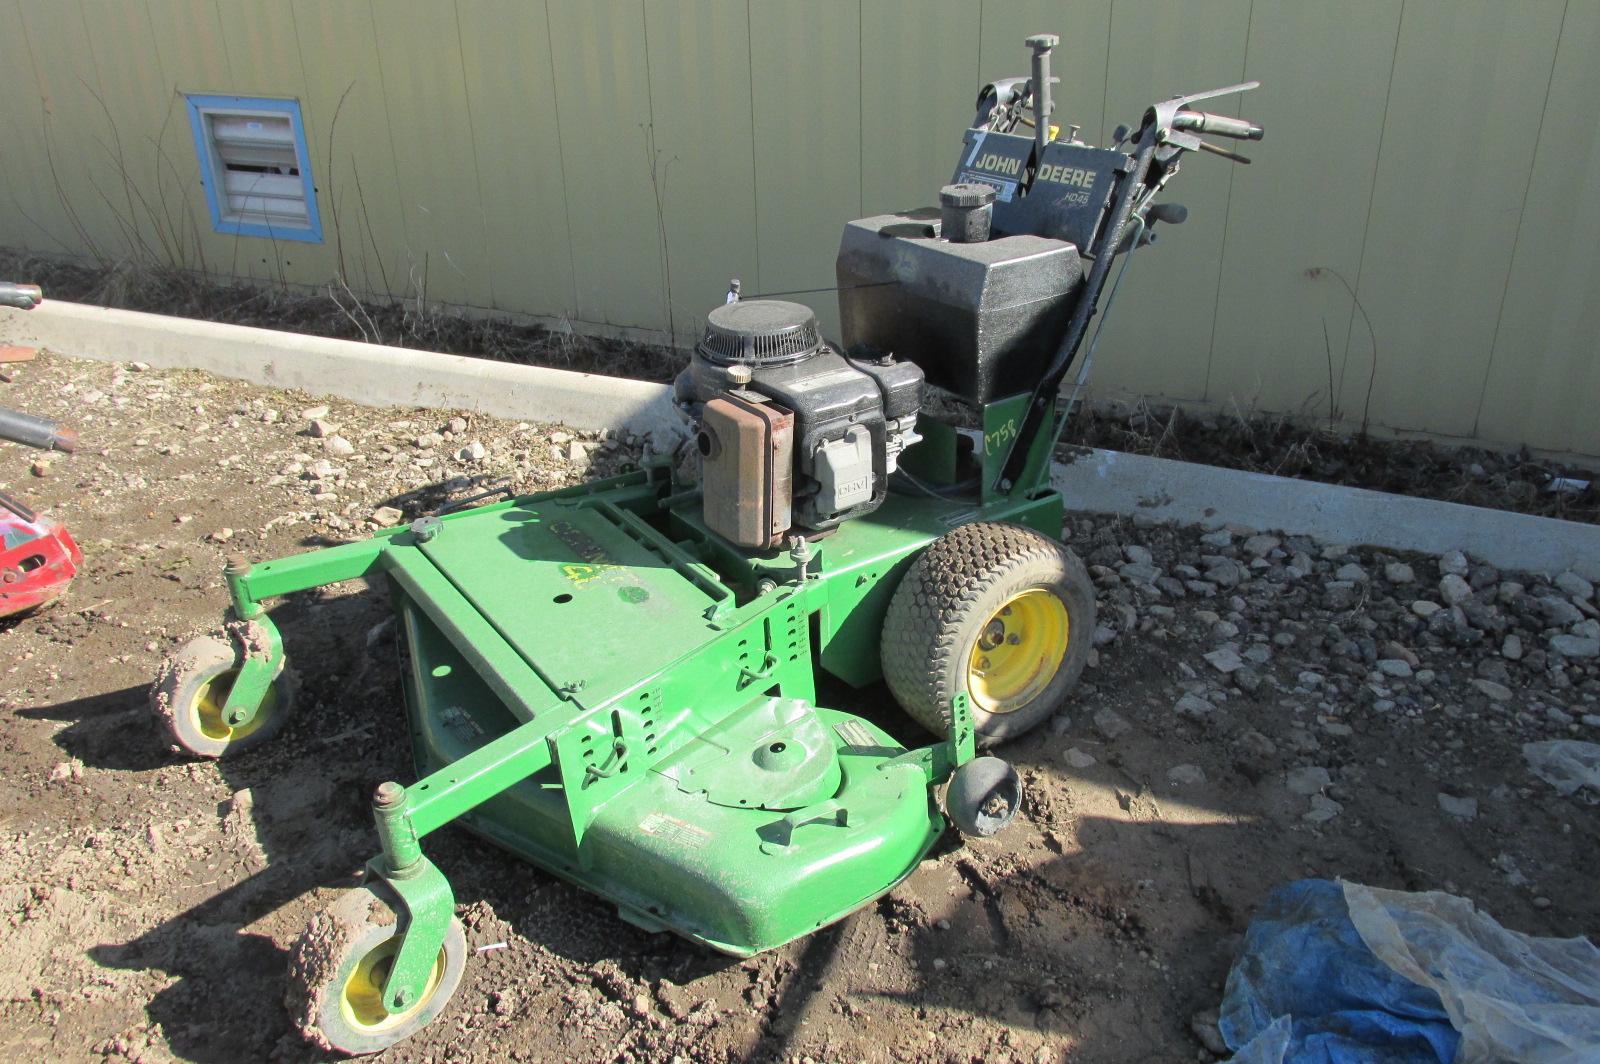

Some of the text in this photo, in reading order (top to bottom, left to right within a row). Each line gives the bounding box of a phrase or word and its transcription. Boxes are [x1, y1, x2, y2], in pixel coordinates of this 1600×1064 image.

[975, 154, 1096, 188] JOHN DEERE
[1064, 191, 1089, 204] HD45
